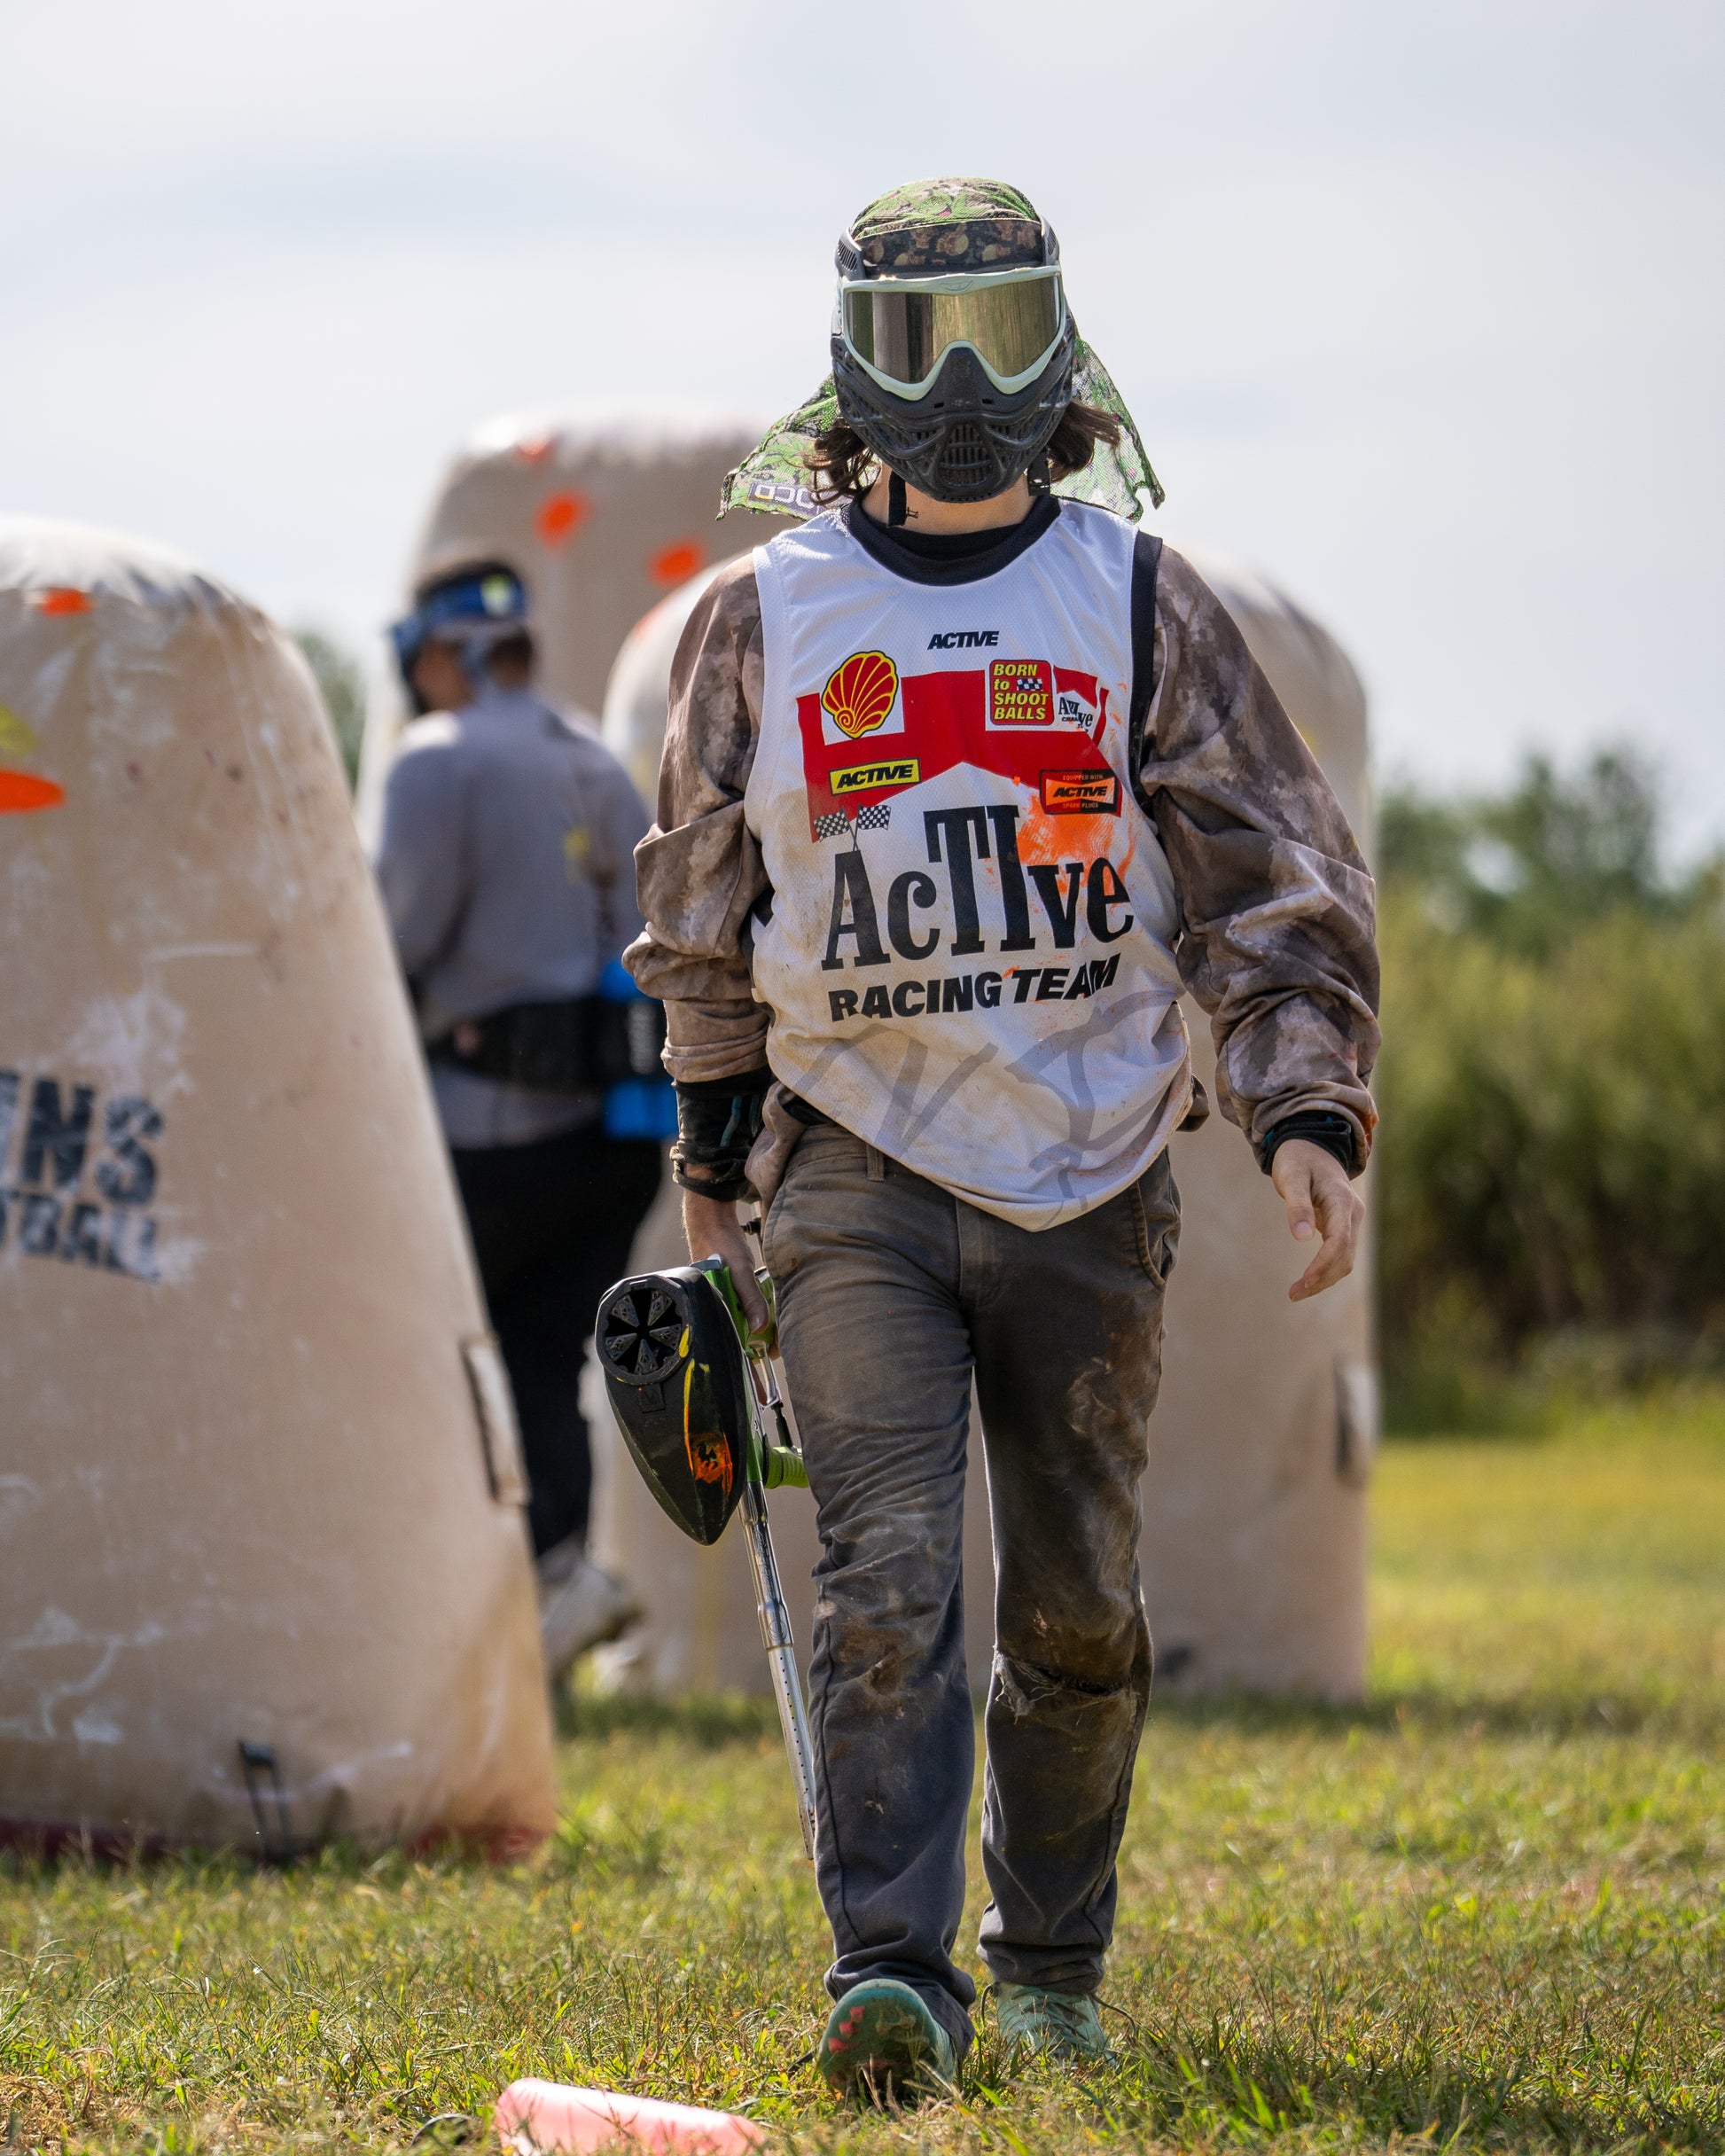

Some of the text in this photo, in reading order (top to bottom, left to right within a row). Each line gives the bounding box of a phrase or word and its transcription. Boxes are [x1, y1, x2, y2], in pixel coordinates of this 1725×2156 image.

[927, 631, 1000, 650] ACTIVE
[993, 664, 1038, 676] BORN
[994, 678, 1011, 691] to
[994, 692, 1050, 706] SHOOT
[994, 707, 1046, 720] BALLS
[837, 764, 914, 789] ACTIVE
[1052, 786, 1107, 797] ACTIVE
[828, 953, 1121, 1022] RACING TEAM
